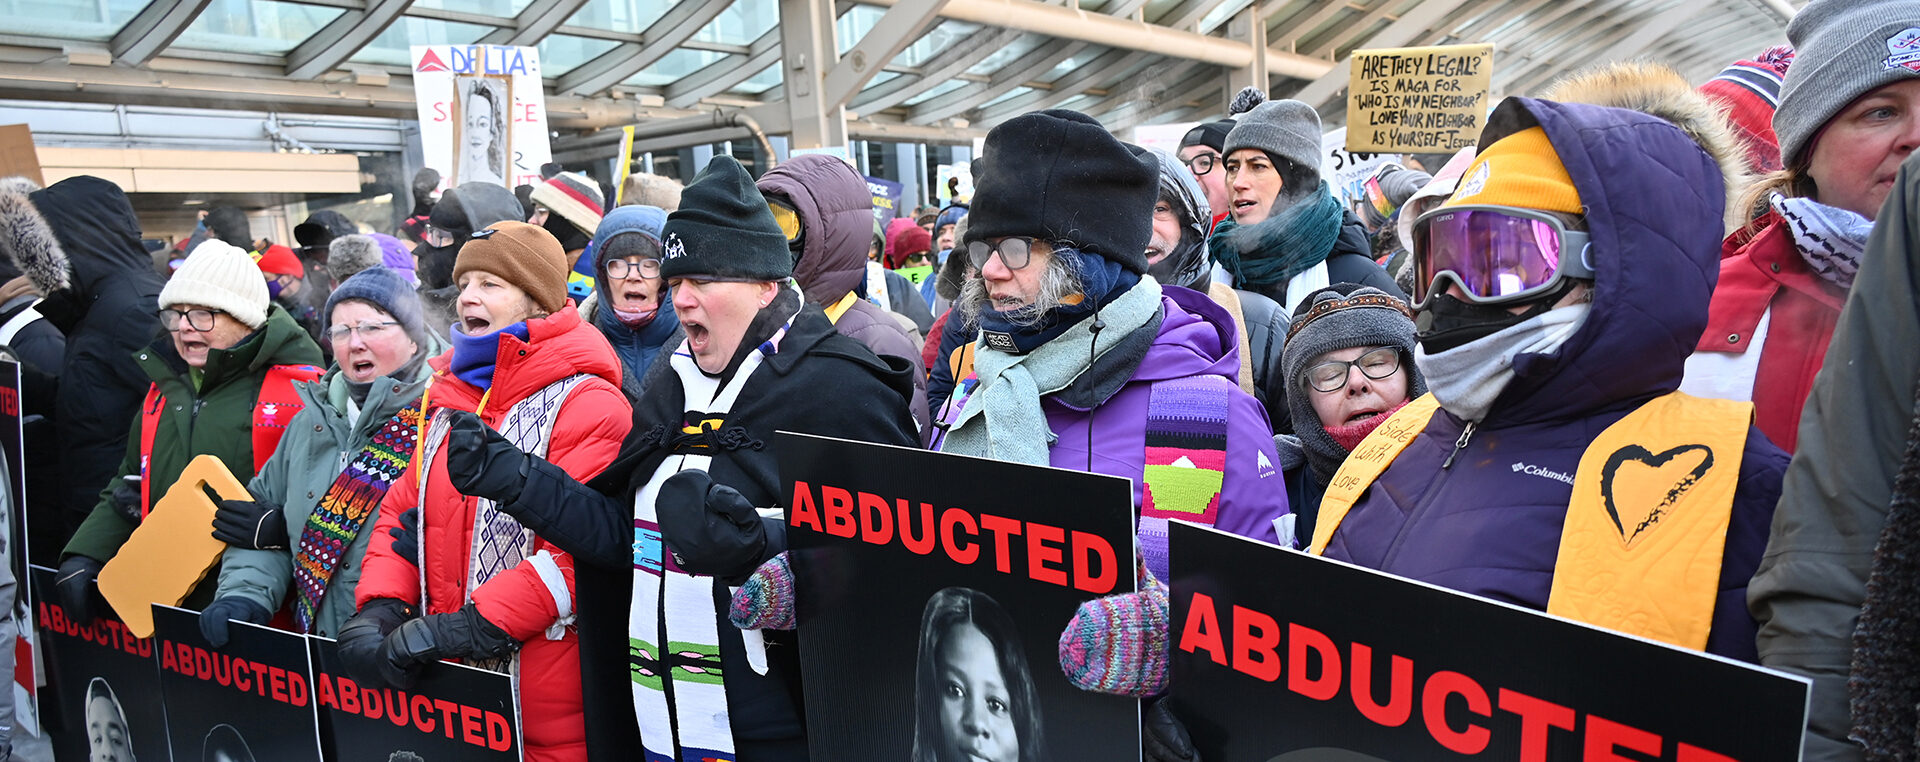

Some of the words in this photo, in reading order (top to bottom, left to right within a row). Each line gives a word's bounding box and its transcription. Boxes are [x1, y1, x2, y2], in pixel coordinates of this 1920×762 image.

[1370, 80, 1389, 93] IS
[1394, 79, 1429, 93] MAGA
[1434, 79, 1462, 92] FOR
[1384, 95, 1400, 109] IS
[1402, 95, 1420, 109] MY
[1370, 111, 1398, 126] LOVE
[1426, 112, 1476, 129] NEIGHBOR
[1372, 130, 1386, 145] AS
[1437, 214, 1454, 222] GIRO
[1333, 467, 1360, 491] Love
[790, 480, 1118, 594] ABDUCTED
[162, 639, 308, 707] ABDUCTED
[1178, 591, 1743, 762] ABDUCTE
[318, 672, 512, 752] ABDUCTED
